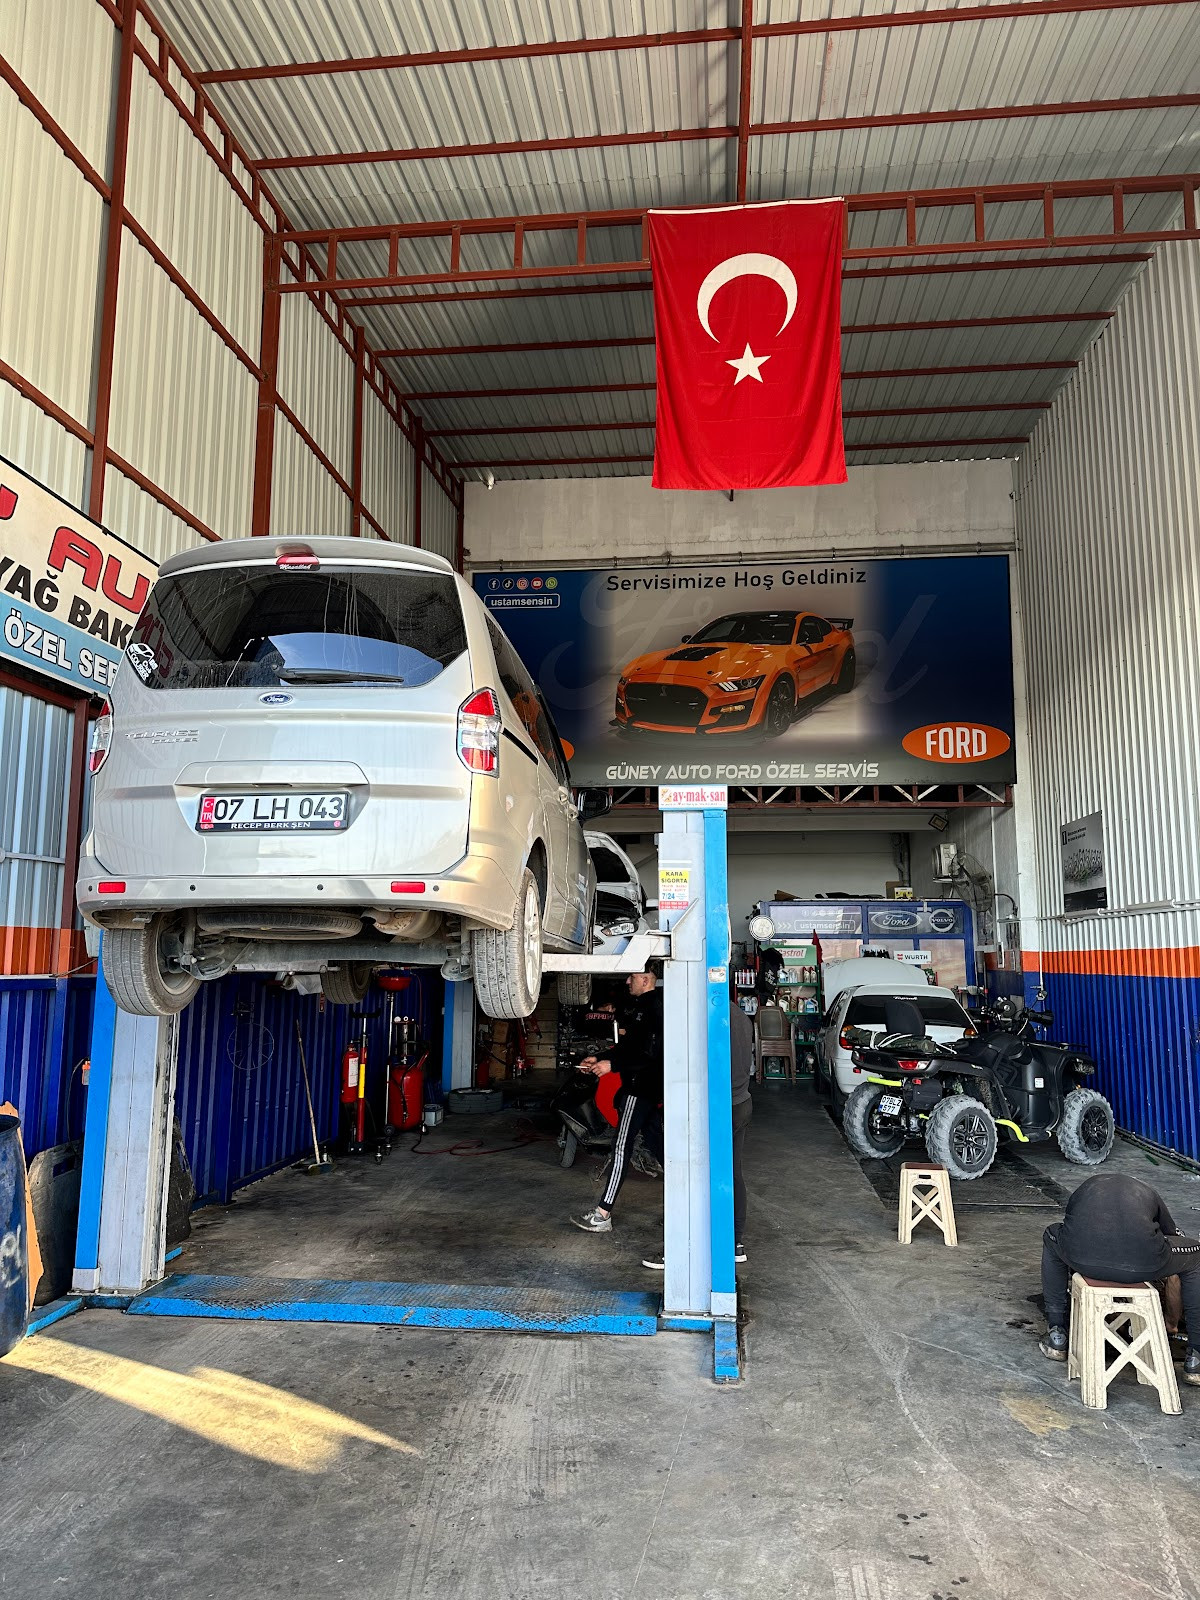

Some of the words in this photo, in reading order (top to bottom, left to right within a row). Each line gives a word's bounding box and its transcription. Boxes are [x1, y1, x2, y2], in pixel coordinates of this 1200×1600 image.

[606, 572, 727, 591] Servisimize
[734, 572, 774, 590] Hoş
[781, 568, 867, 586] Geldiniz
[491, 597, 553, 606] ustamsensin
[4, 608, 72, 671] ÖZEL
[925, 727, 987, 759] FORD
[606, 762, 661, 780] GÜNEY
[665, 764, 711, 780] AUTO
[715, 764, 762, 779] FORD
[766, 760, 810, 779] ÖZEL
[814, 760, 879, 778] SERVİS
[202, 812, 213, 821] TR
[214, 798, 245, 821] 07
[253, 798, 290, 820] LH
[298, 796, 344, 819] 043
[230, 822, 262, 830] RECEP
[291, 821, 311, 829] ŞEN
[800, 921, 850, 929] ustamsensin
[882, 914, 910, 926] Ford
